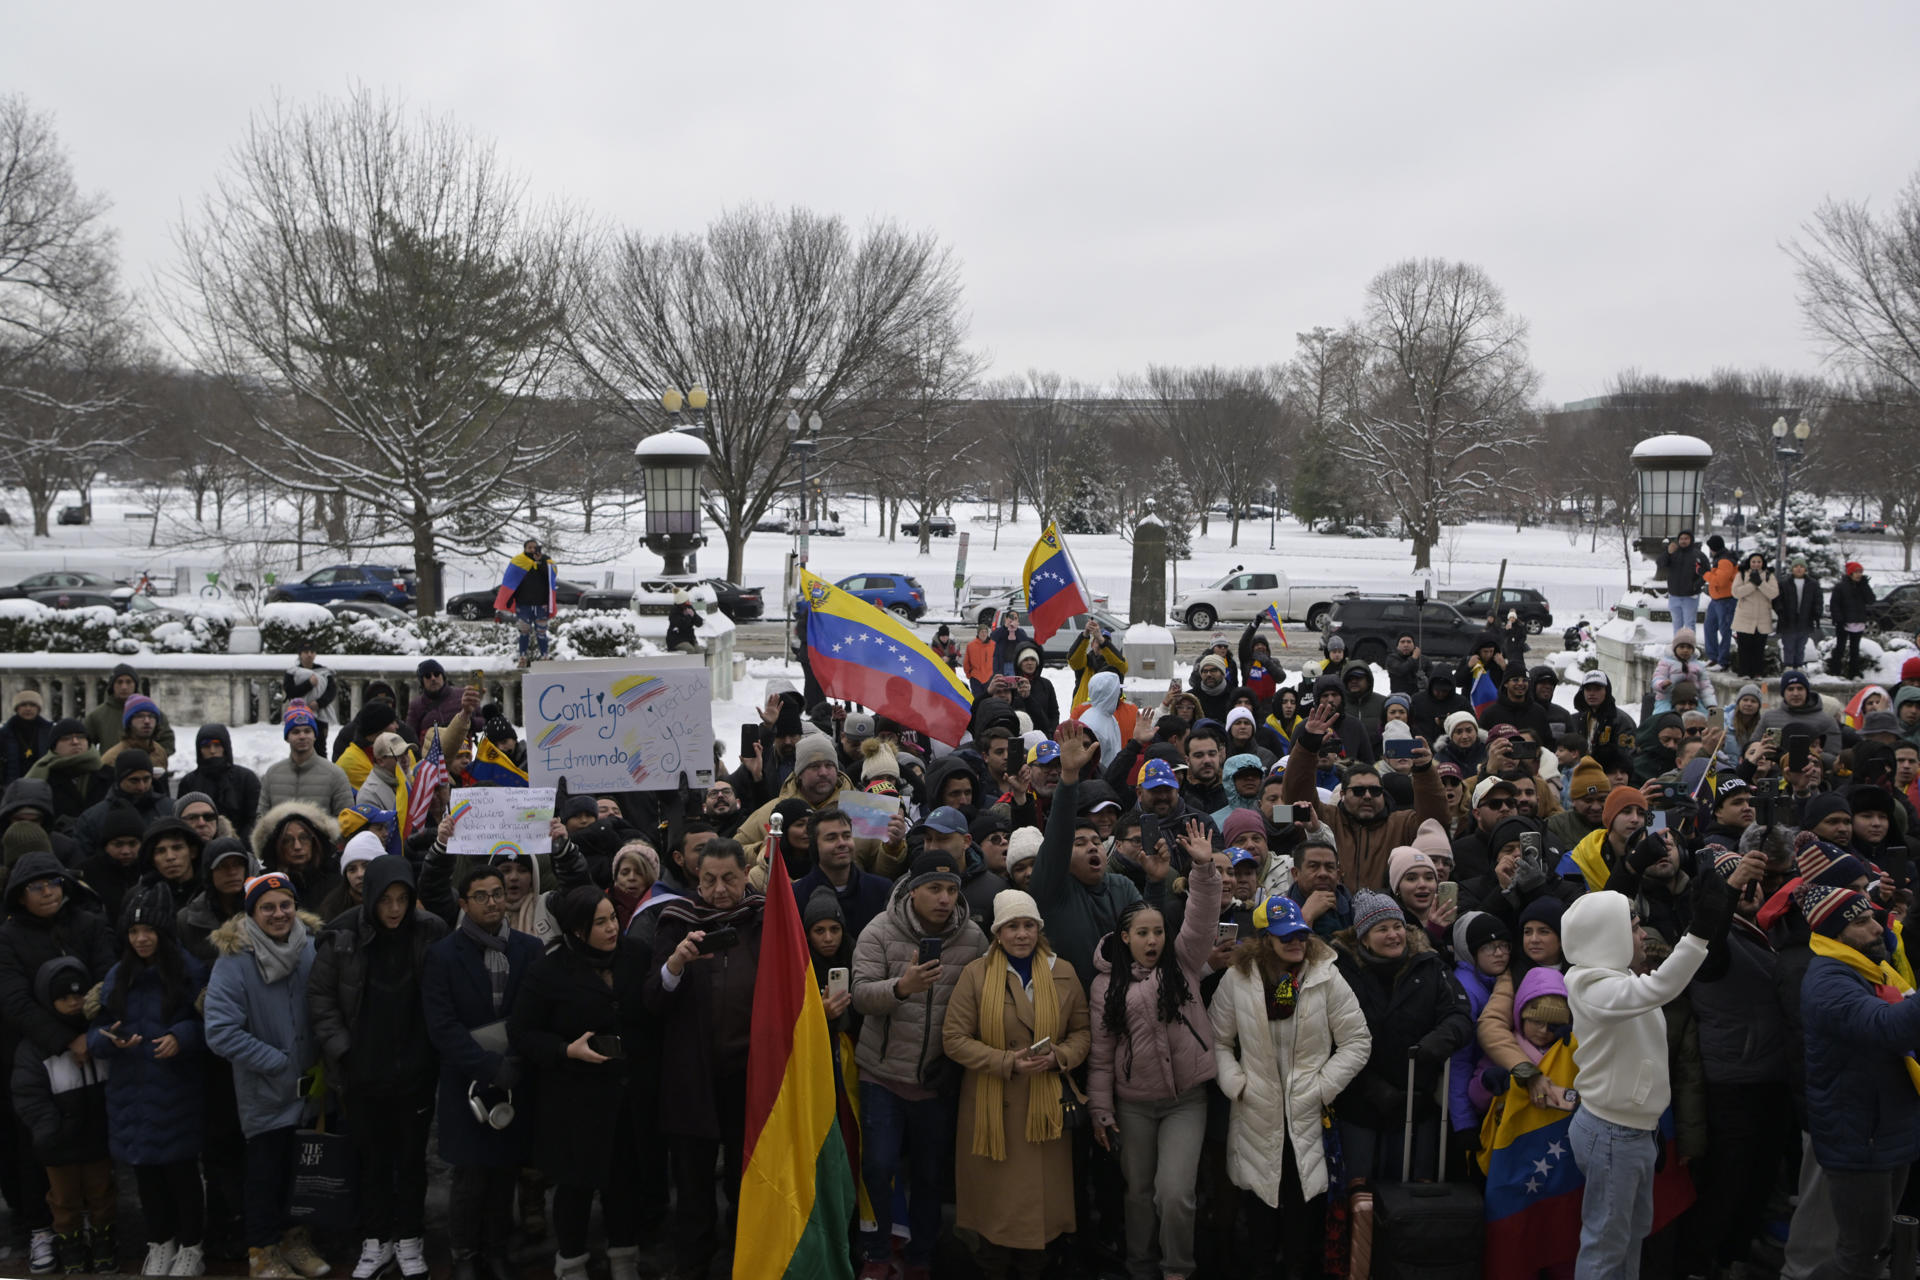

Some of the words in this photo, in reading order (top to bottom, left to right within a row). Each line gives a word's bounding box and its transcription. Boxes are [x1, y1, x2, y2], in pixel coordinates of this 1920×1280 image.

[538, 684, 626, 739] Contigo
[642, 675, 707, 728] Libertad
[541, 744, 628, 771] Edmundo
[469, 806, 504, 819] Quiero
